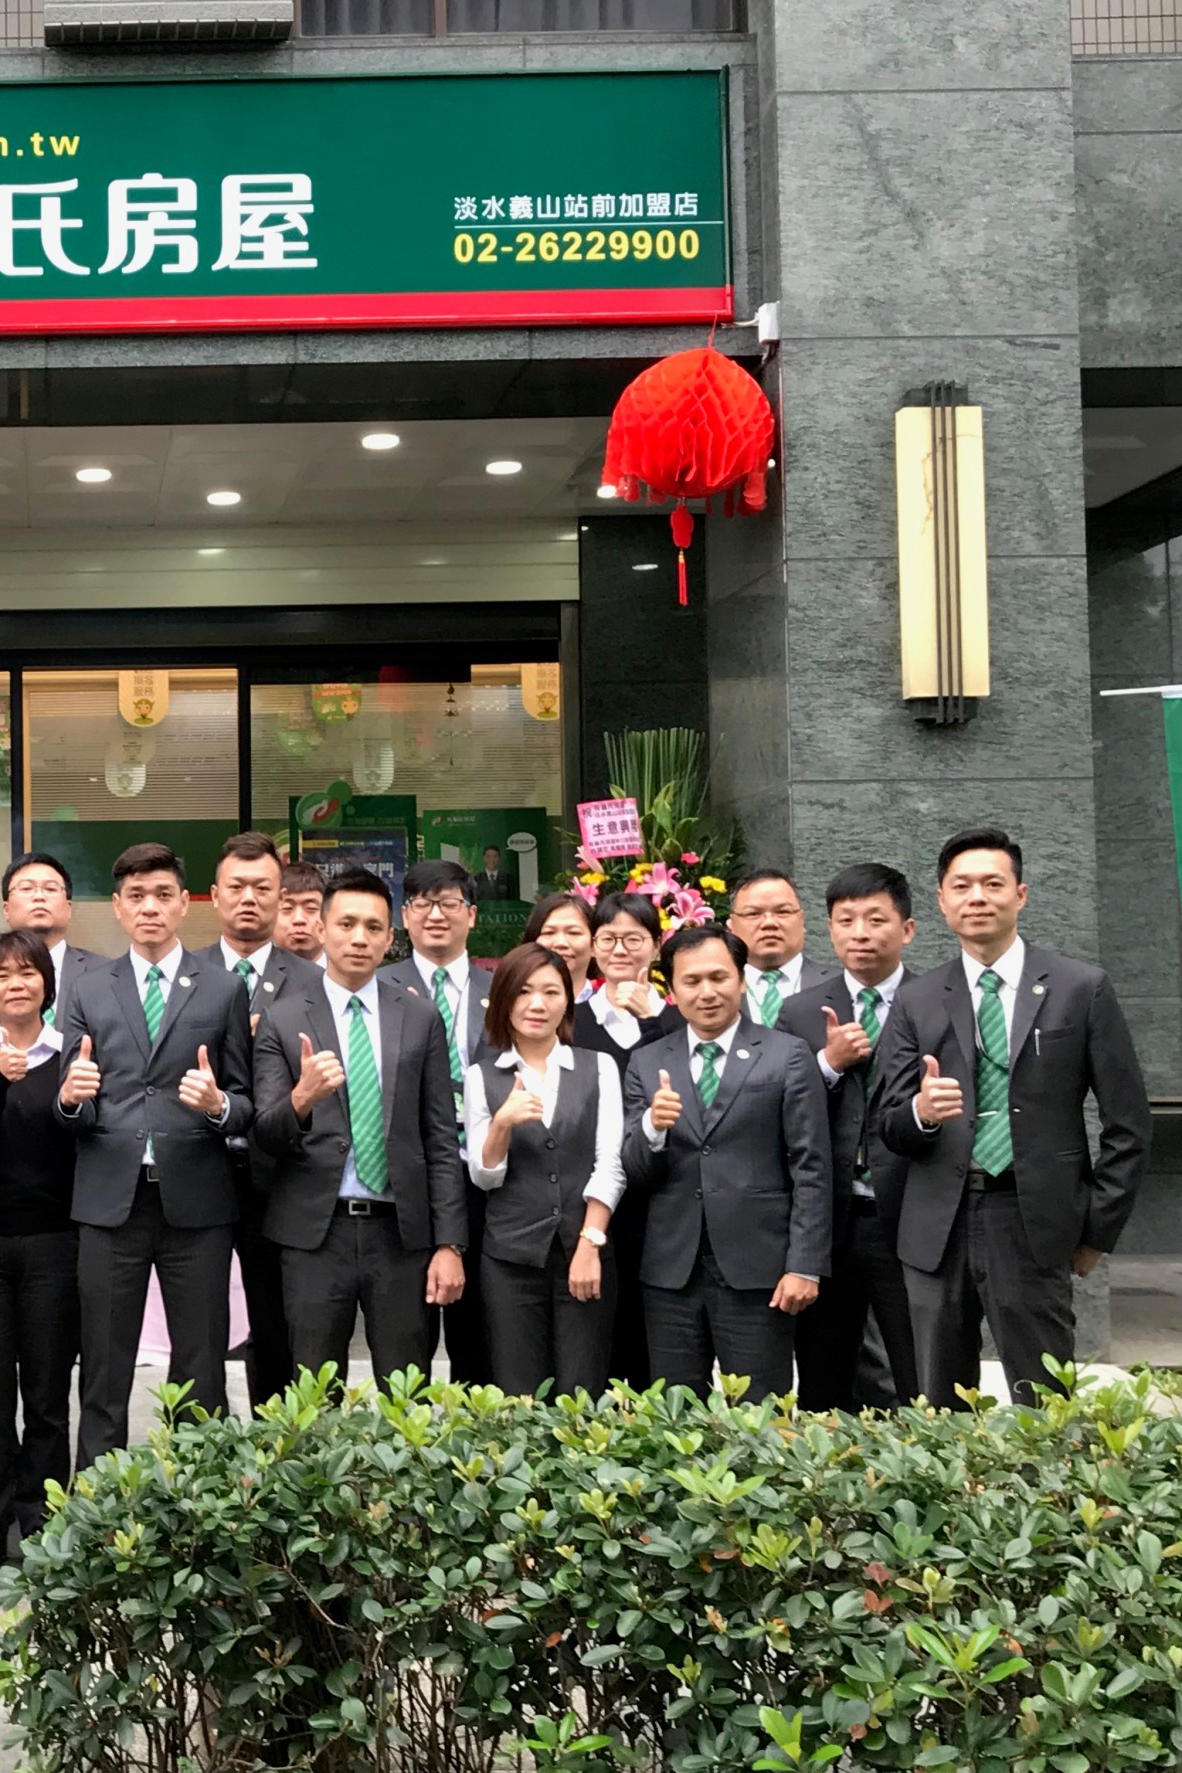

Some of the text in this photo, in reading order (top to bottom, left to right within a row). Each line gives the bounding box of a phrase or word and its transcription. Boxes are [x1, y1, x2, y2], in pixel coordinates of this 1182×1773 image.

[453, 191, 698, 221] 淡水義山站前加盟店
[453, 229, 700, 263] 02-26229900
